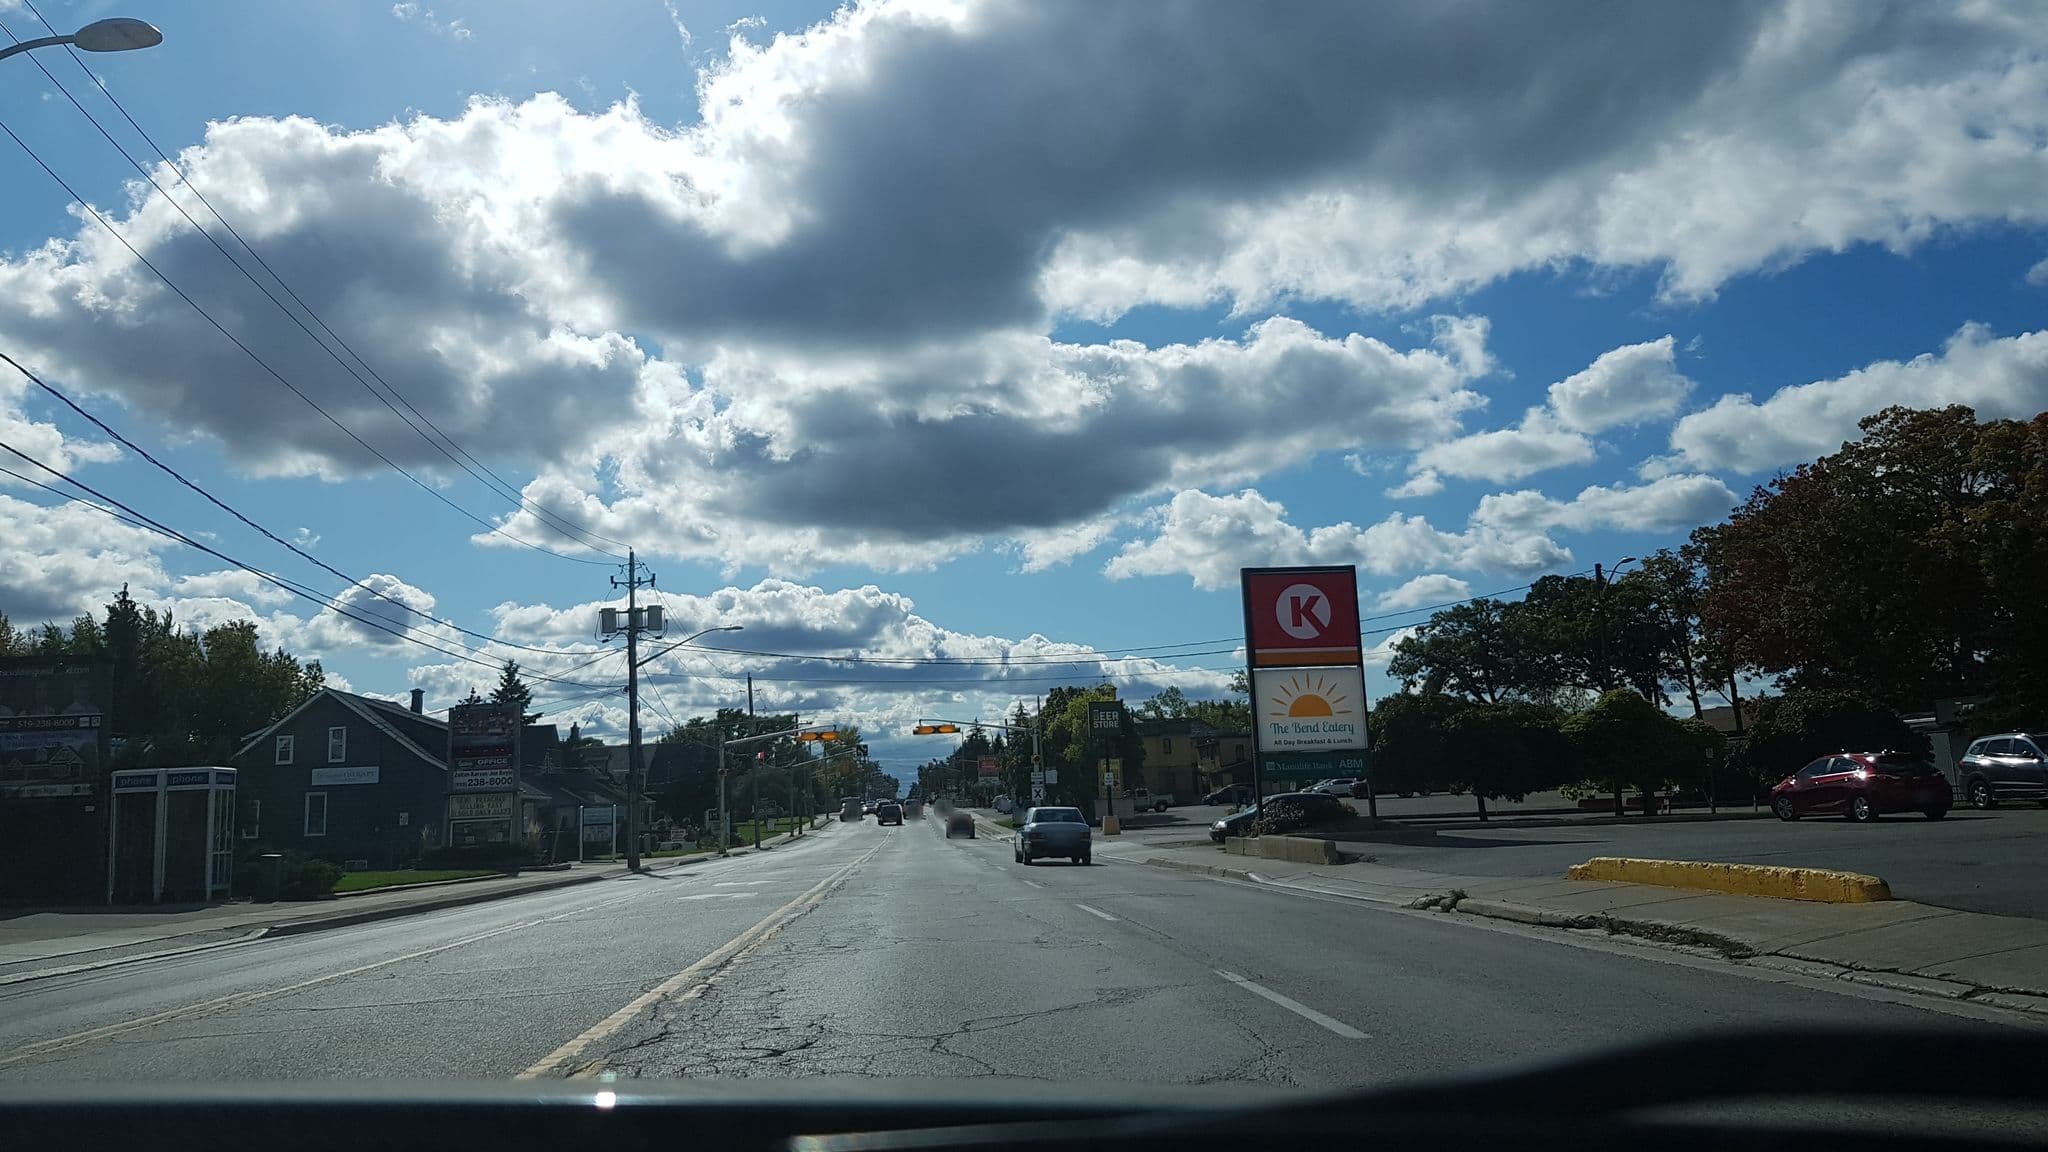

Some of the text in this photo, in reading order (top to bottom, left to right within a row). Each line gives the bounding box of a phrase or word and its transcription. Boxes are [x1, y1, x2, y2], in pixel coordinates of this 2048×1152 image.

[1290, 595, 1328, 636] K
[1093, 711, 1119, 721] BEER
[1093, 720, 1120, 729] STORE
[1269, 720, 1354, 735] The Bend Eatery
[1283, 739, 1295, 747] Day
[1338, 759, 1363, 769] ABM
[172, 774, 205, 785] phone
[467, 777, 513, 786] 238-8000
